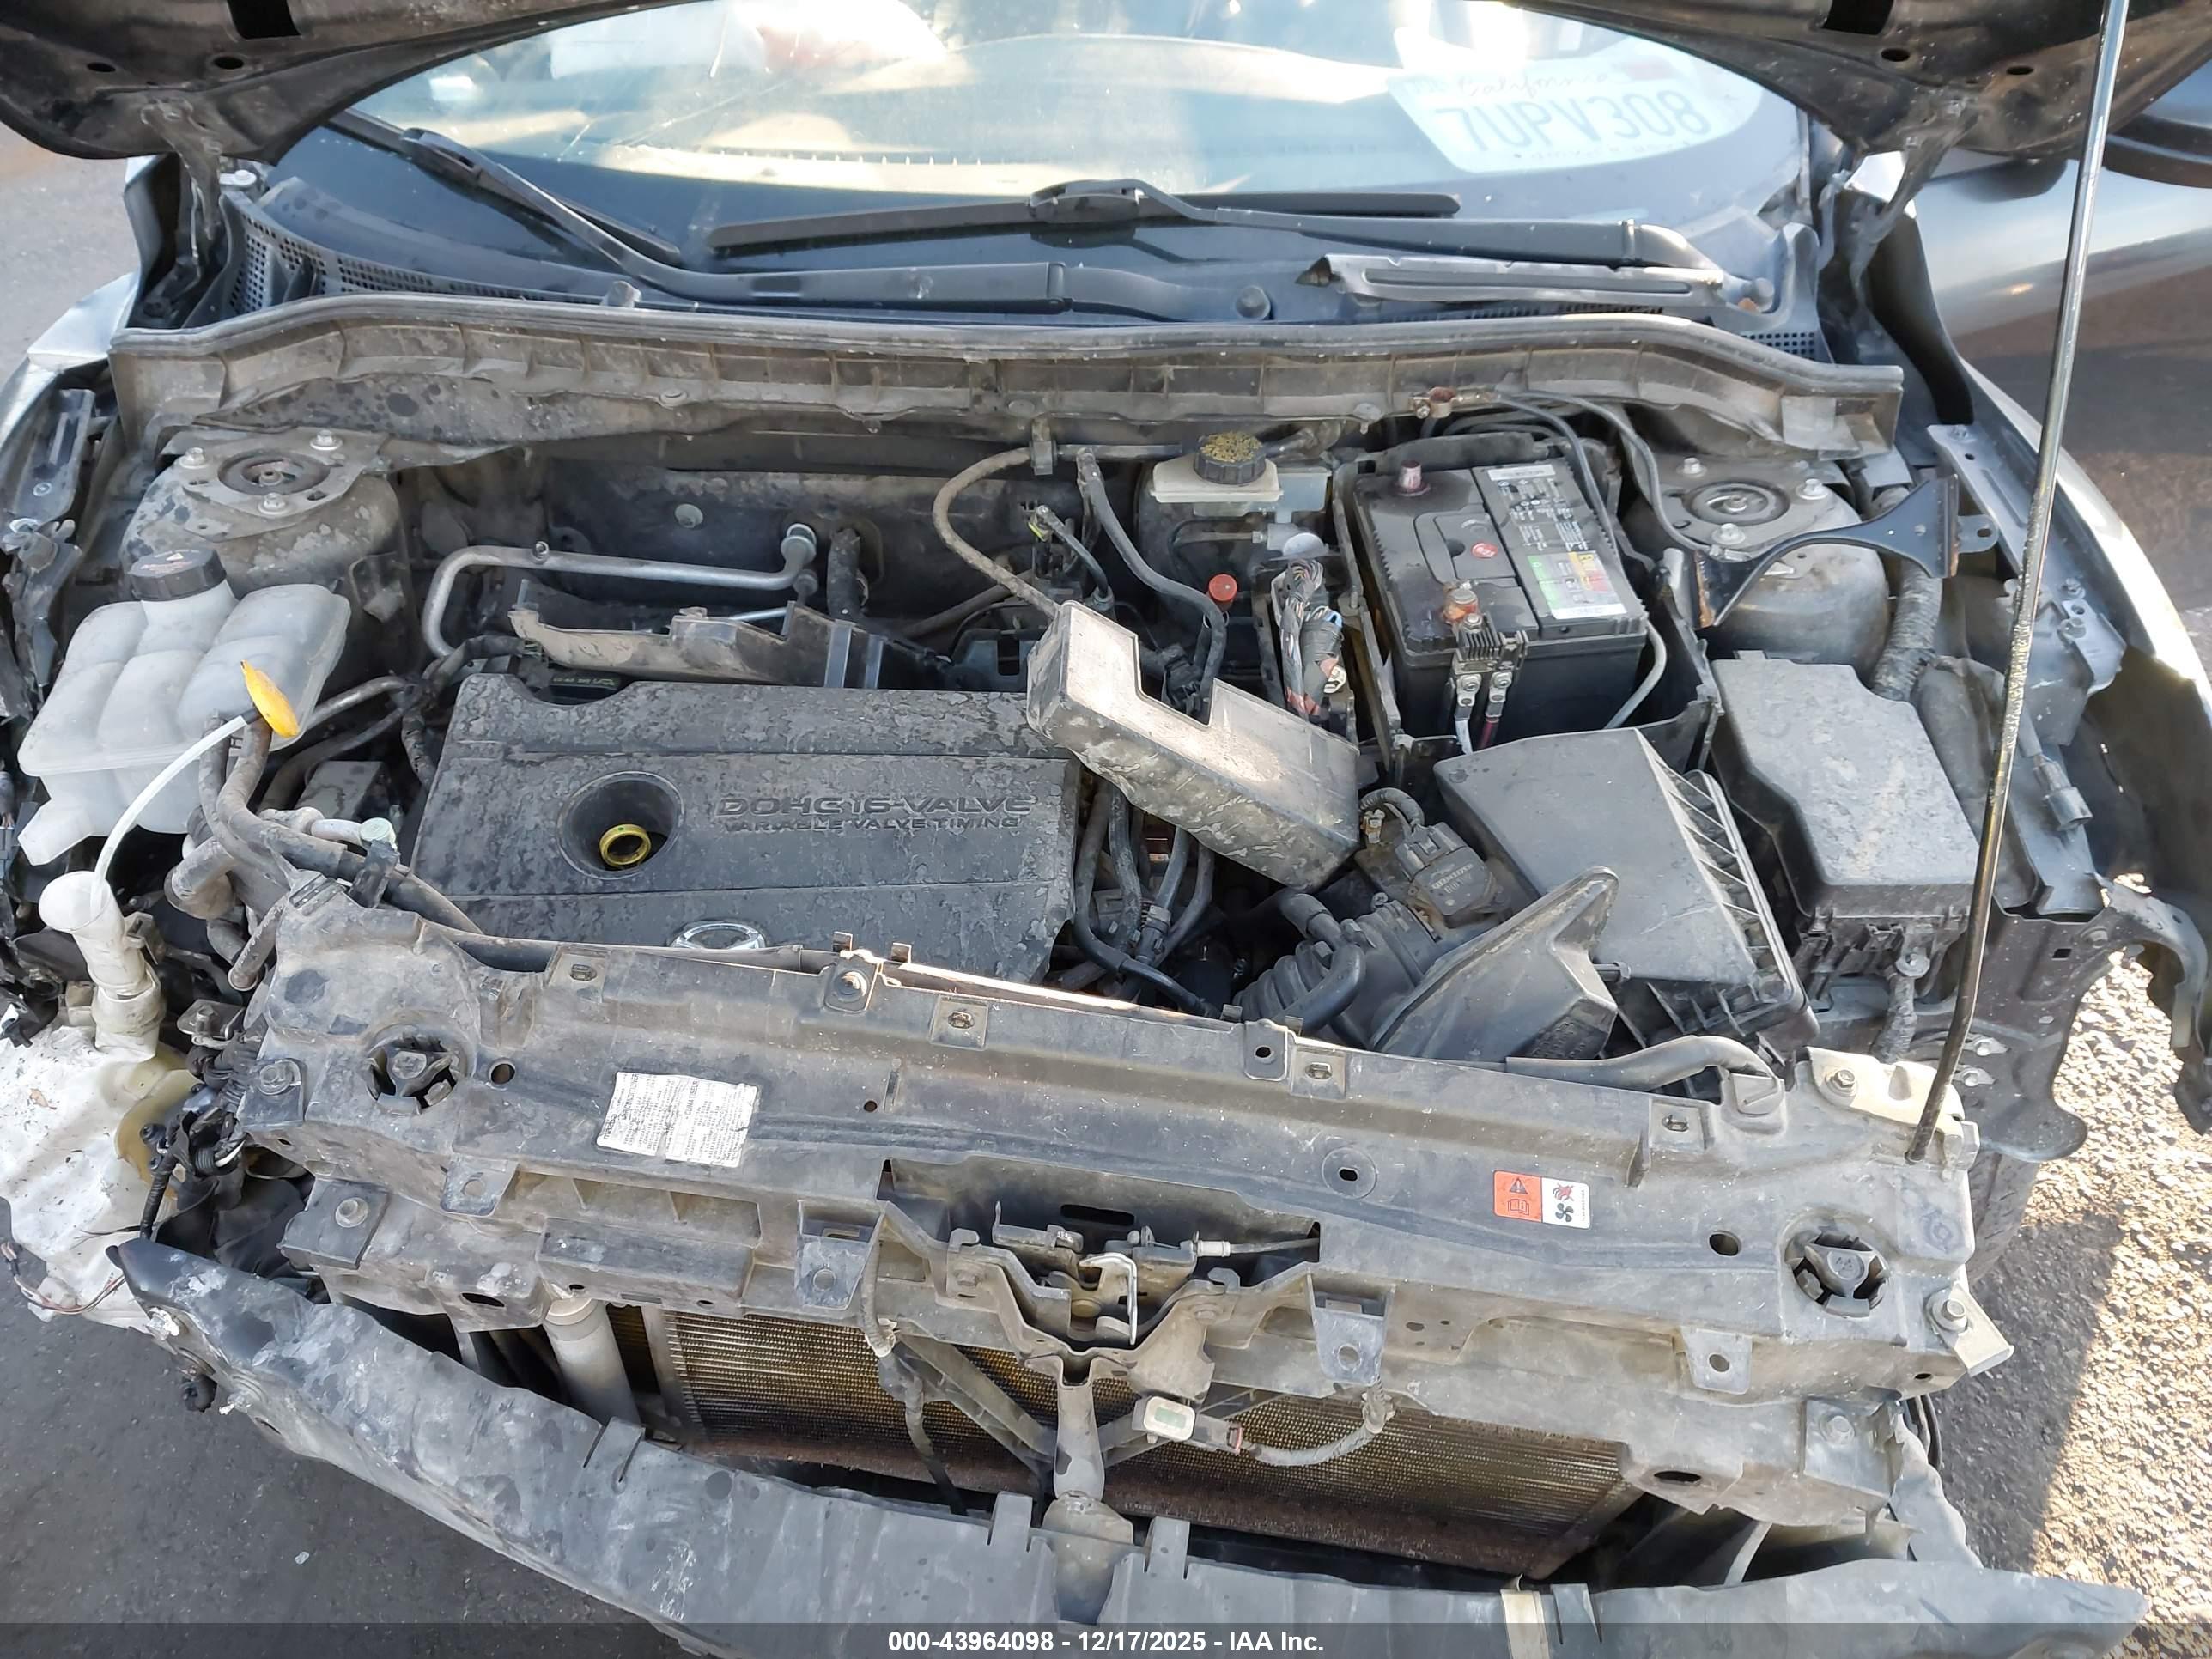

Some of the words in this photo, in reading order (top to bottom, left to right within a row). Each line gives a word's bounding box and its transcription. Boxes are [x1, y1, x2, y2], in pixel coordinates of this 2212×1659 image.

[1457, 71, 1610, 99] California
[1435, 89, 1711, 152] 7UPV308
[716, 795, 845, 817] DOHC
[850, 794, 1038, 817] 16-VALVE
[724, 818, 844, 832] VARIABLE
[853, 817, 927, 831] VALVE
[932, 817, 1022, 830] TIMING
[603, 1114, 617, 1140] mazda
